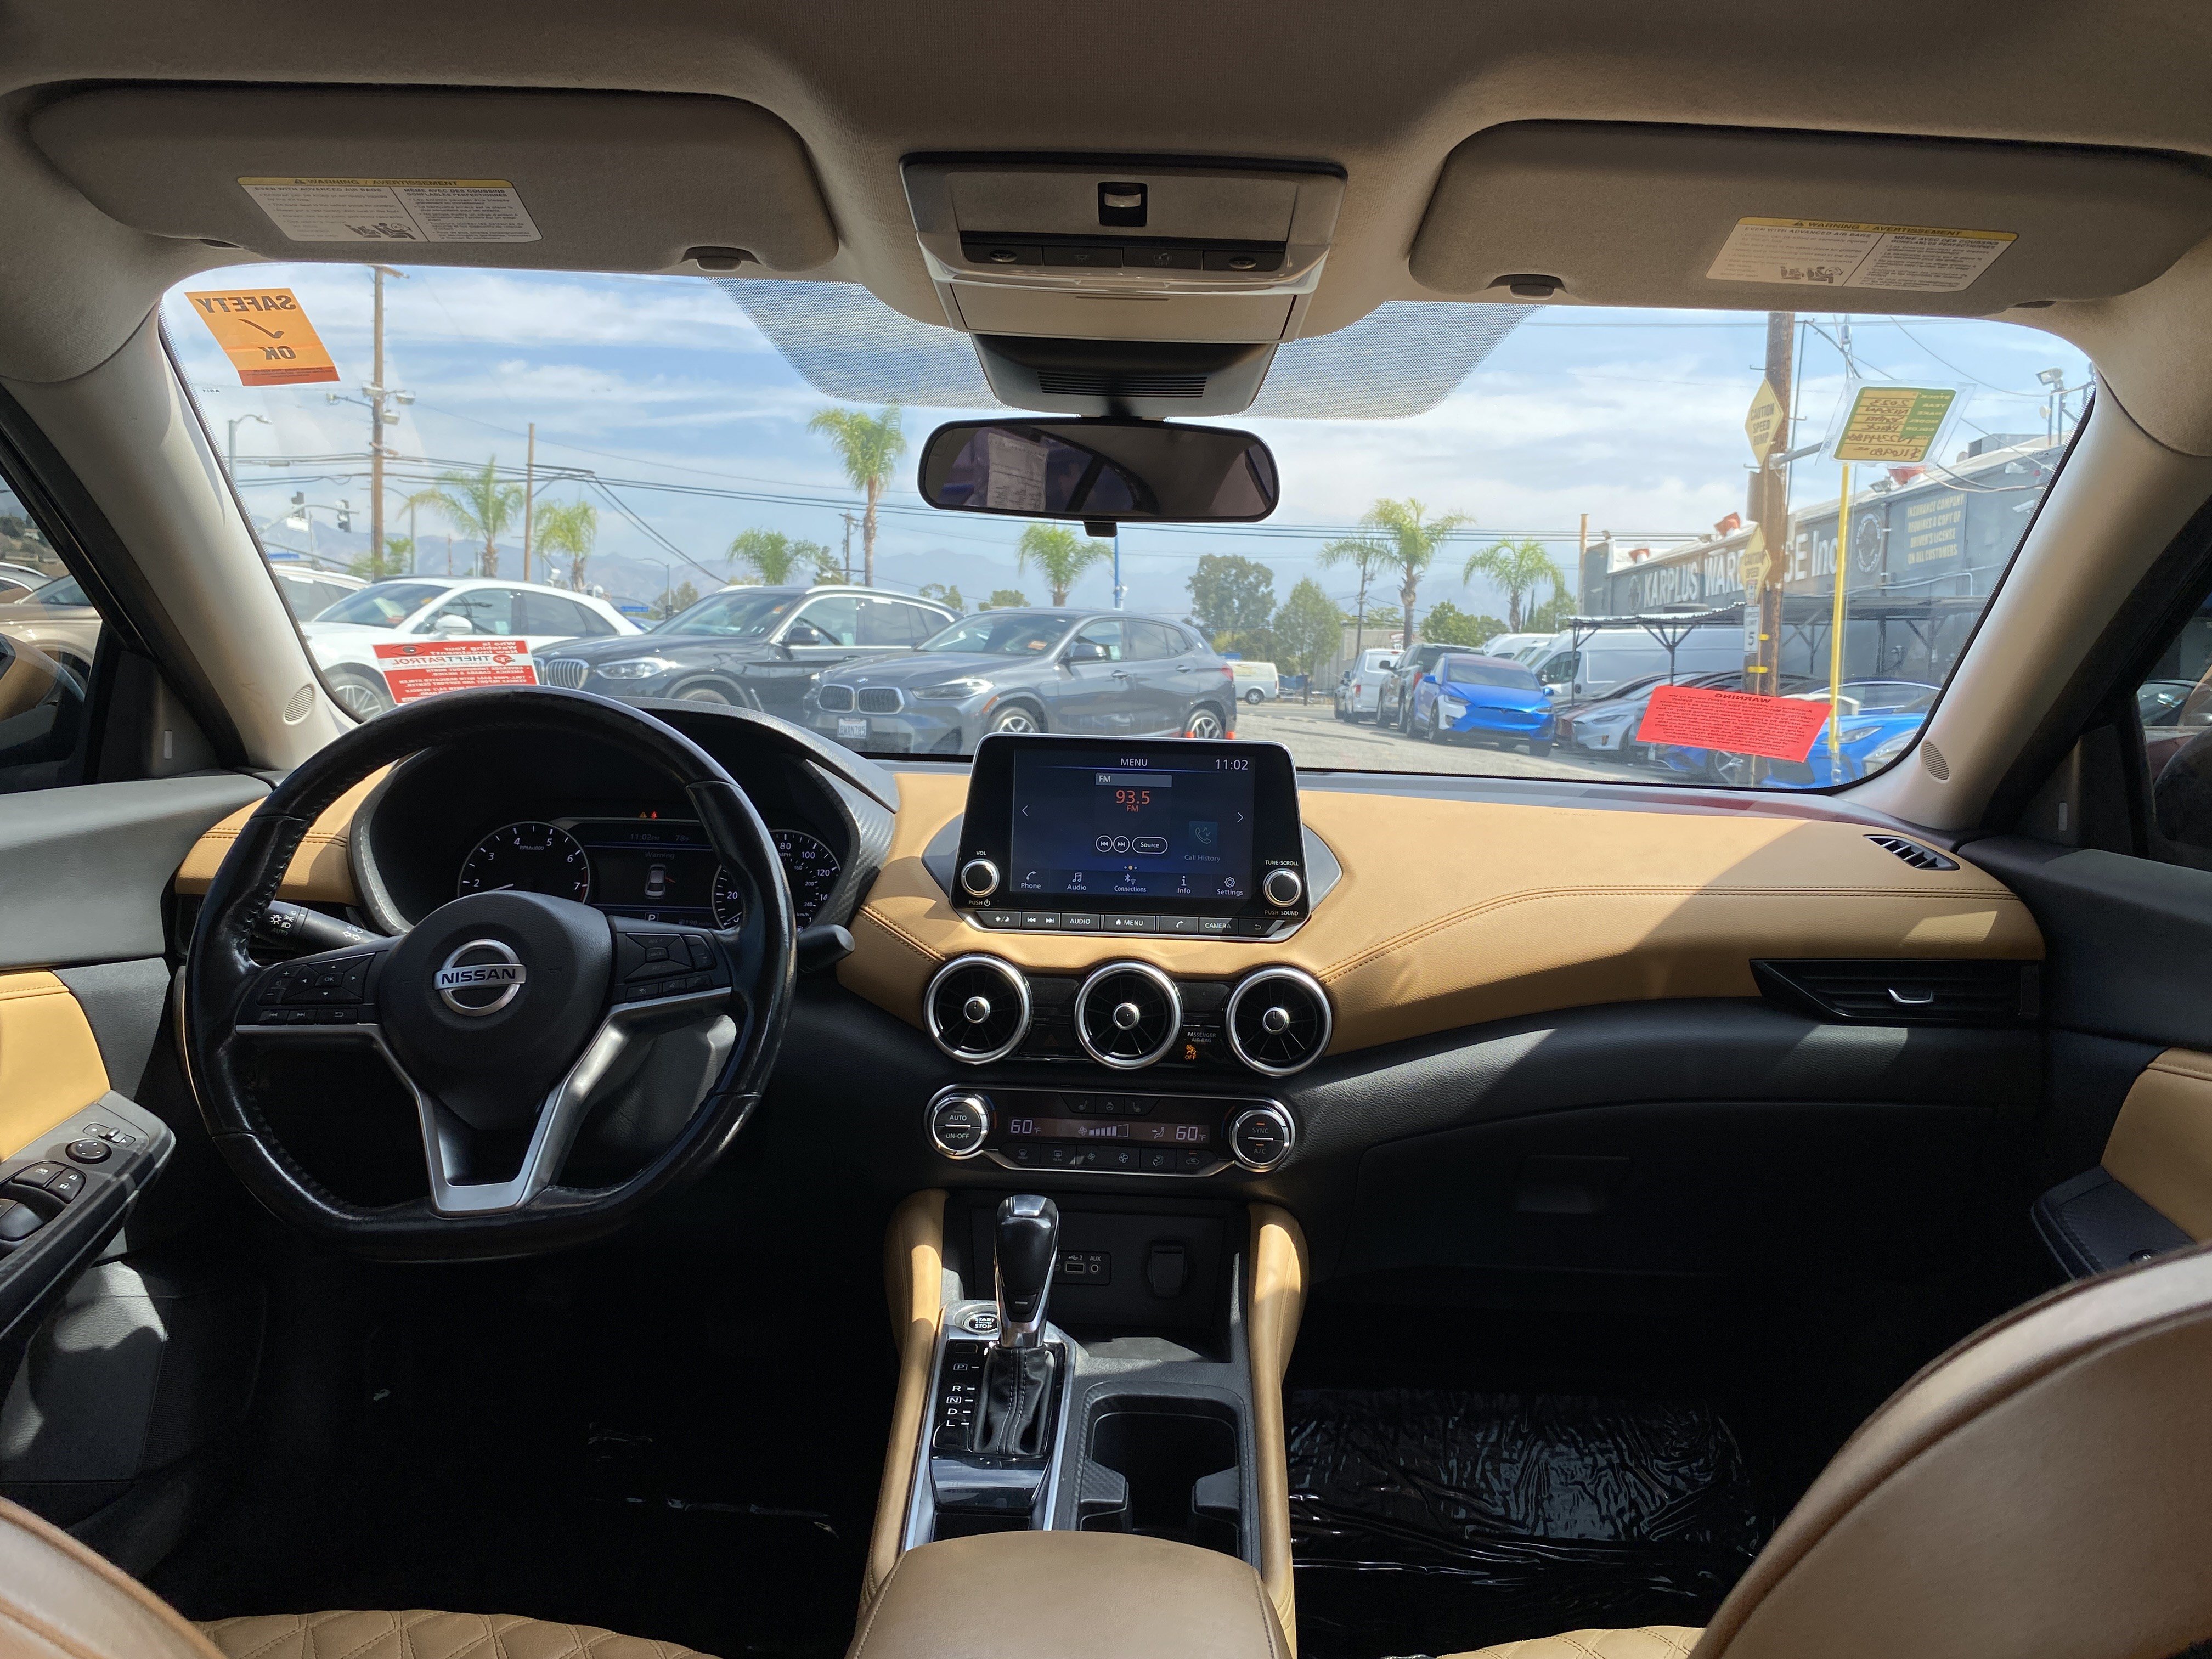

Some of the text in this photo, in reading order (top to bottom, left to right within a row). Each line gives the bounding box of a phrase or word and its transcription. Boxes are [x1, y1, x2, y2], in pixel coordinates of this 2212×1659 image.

[1808, 222, 1962, 236] WARNING AVERTISSEMENT
[1751, 403, 1774, 421] CAUTION
[1753, 419, 1770, 433] SPEED
[1753, 432, 1769, 446] BUMP
[1937, 493, 1965, 511] COMPANY
[1938, 513, 1953, 527] COPY
[1953, 510, 1961, 524] OF
[1934, 528, 1956, 543] LICENSE
[1745, 552, 1763, 566] CAUTION
[1908, 552, 1915, 565] ON
[1925, 544, 1958, 561] CUSTOMERS
[1746, 567, 1759, 578] SPEED
[1644, 561, 1699, 608] KARPLUS
[1748, 631, 1754, 646] 5
[1120, 758, 1249, 771] MENU 11:02
[1116, 789, 1150, 805] 93.5
[1127, 805, 1140, 813] FM
[488, 853, 494, 861] 3
[645, 851, 675, 860] Warning
[1198, 855, 1221, 865] History
[474, 879, 480, 887] 2
[574, 882, 580, 890] 7
[442, 968, 516, 985] NISSAN
